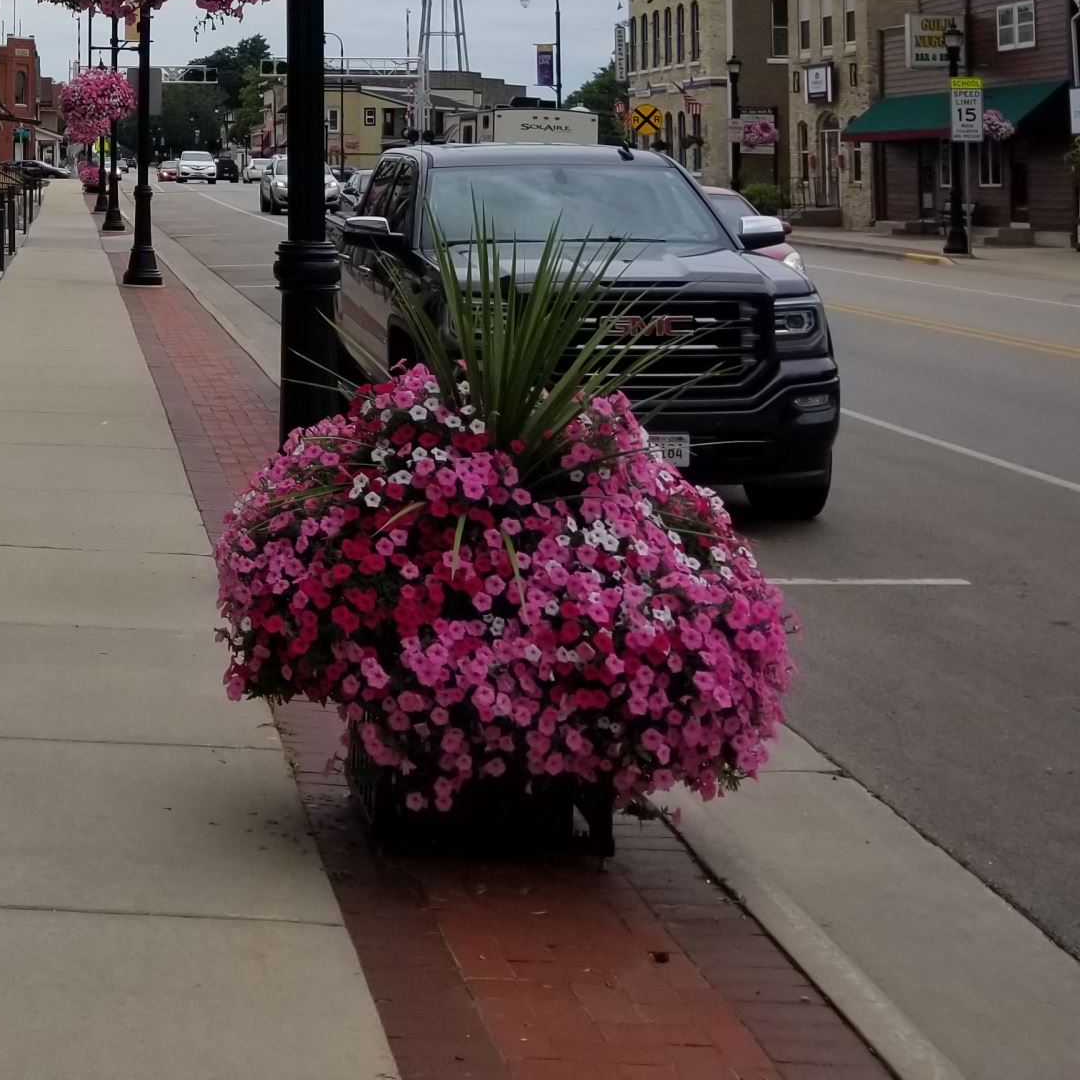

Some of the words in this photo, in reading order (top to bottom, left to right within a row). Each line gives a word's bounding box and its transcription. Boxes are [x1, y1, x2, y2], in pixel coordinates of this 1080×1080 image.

[915, 35, 947, 48] NUGG
[953, 90, 980, 98] SPEED
[955, 98, 977, 106] LIMIT
[633, 115, 639, 124] R
[653, 115, 660, 123] R
[957, 107, 977, 122] 15
[599, 315, 695, 337] GMC
